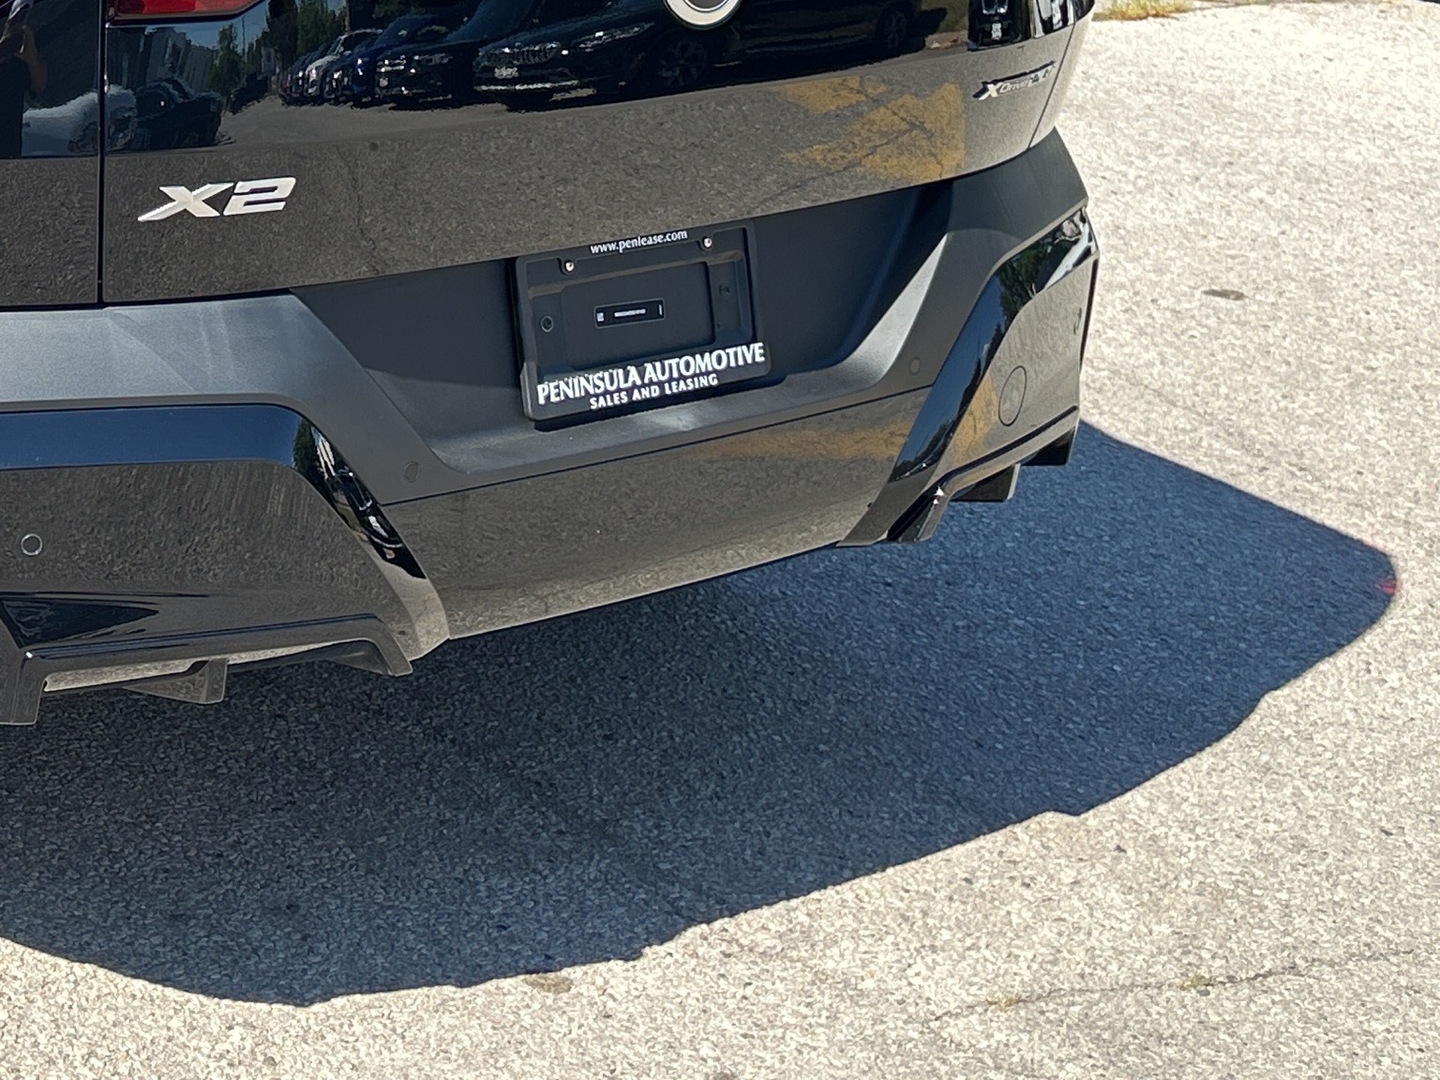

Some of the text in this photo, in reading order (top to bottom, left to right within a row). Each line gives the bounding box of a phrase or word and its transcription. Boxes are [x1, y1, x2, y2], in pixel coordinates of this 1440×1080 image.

[138, 176, 297, 222] X2
[589, 230, 688, 253] www.penlease.com
[537, 342, 765, 405] PENINSULA AUTOMOTIVE
[590, 374, 719, 410] SALES AND LEASING
